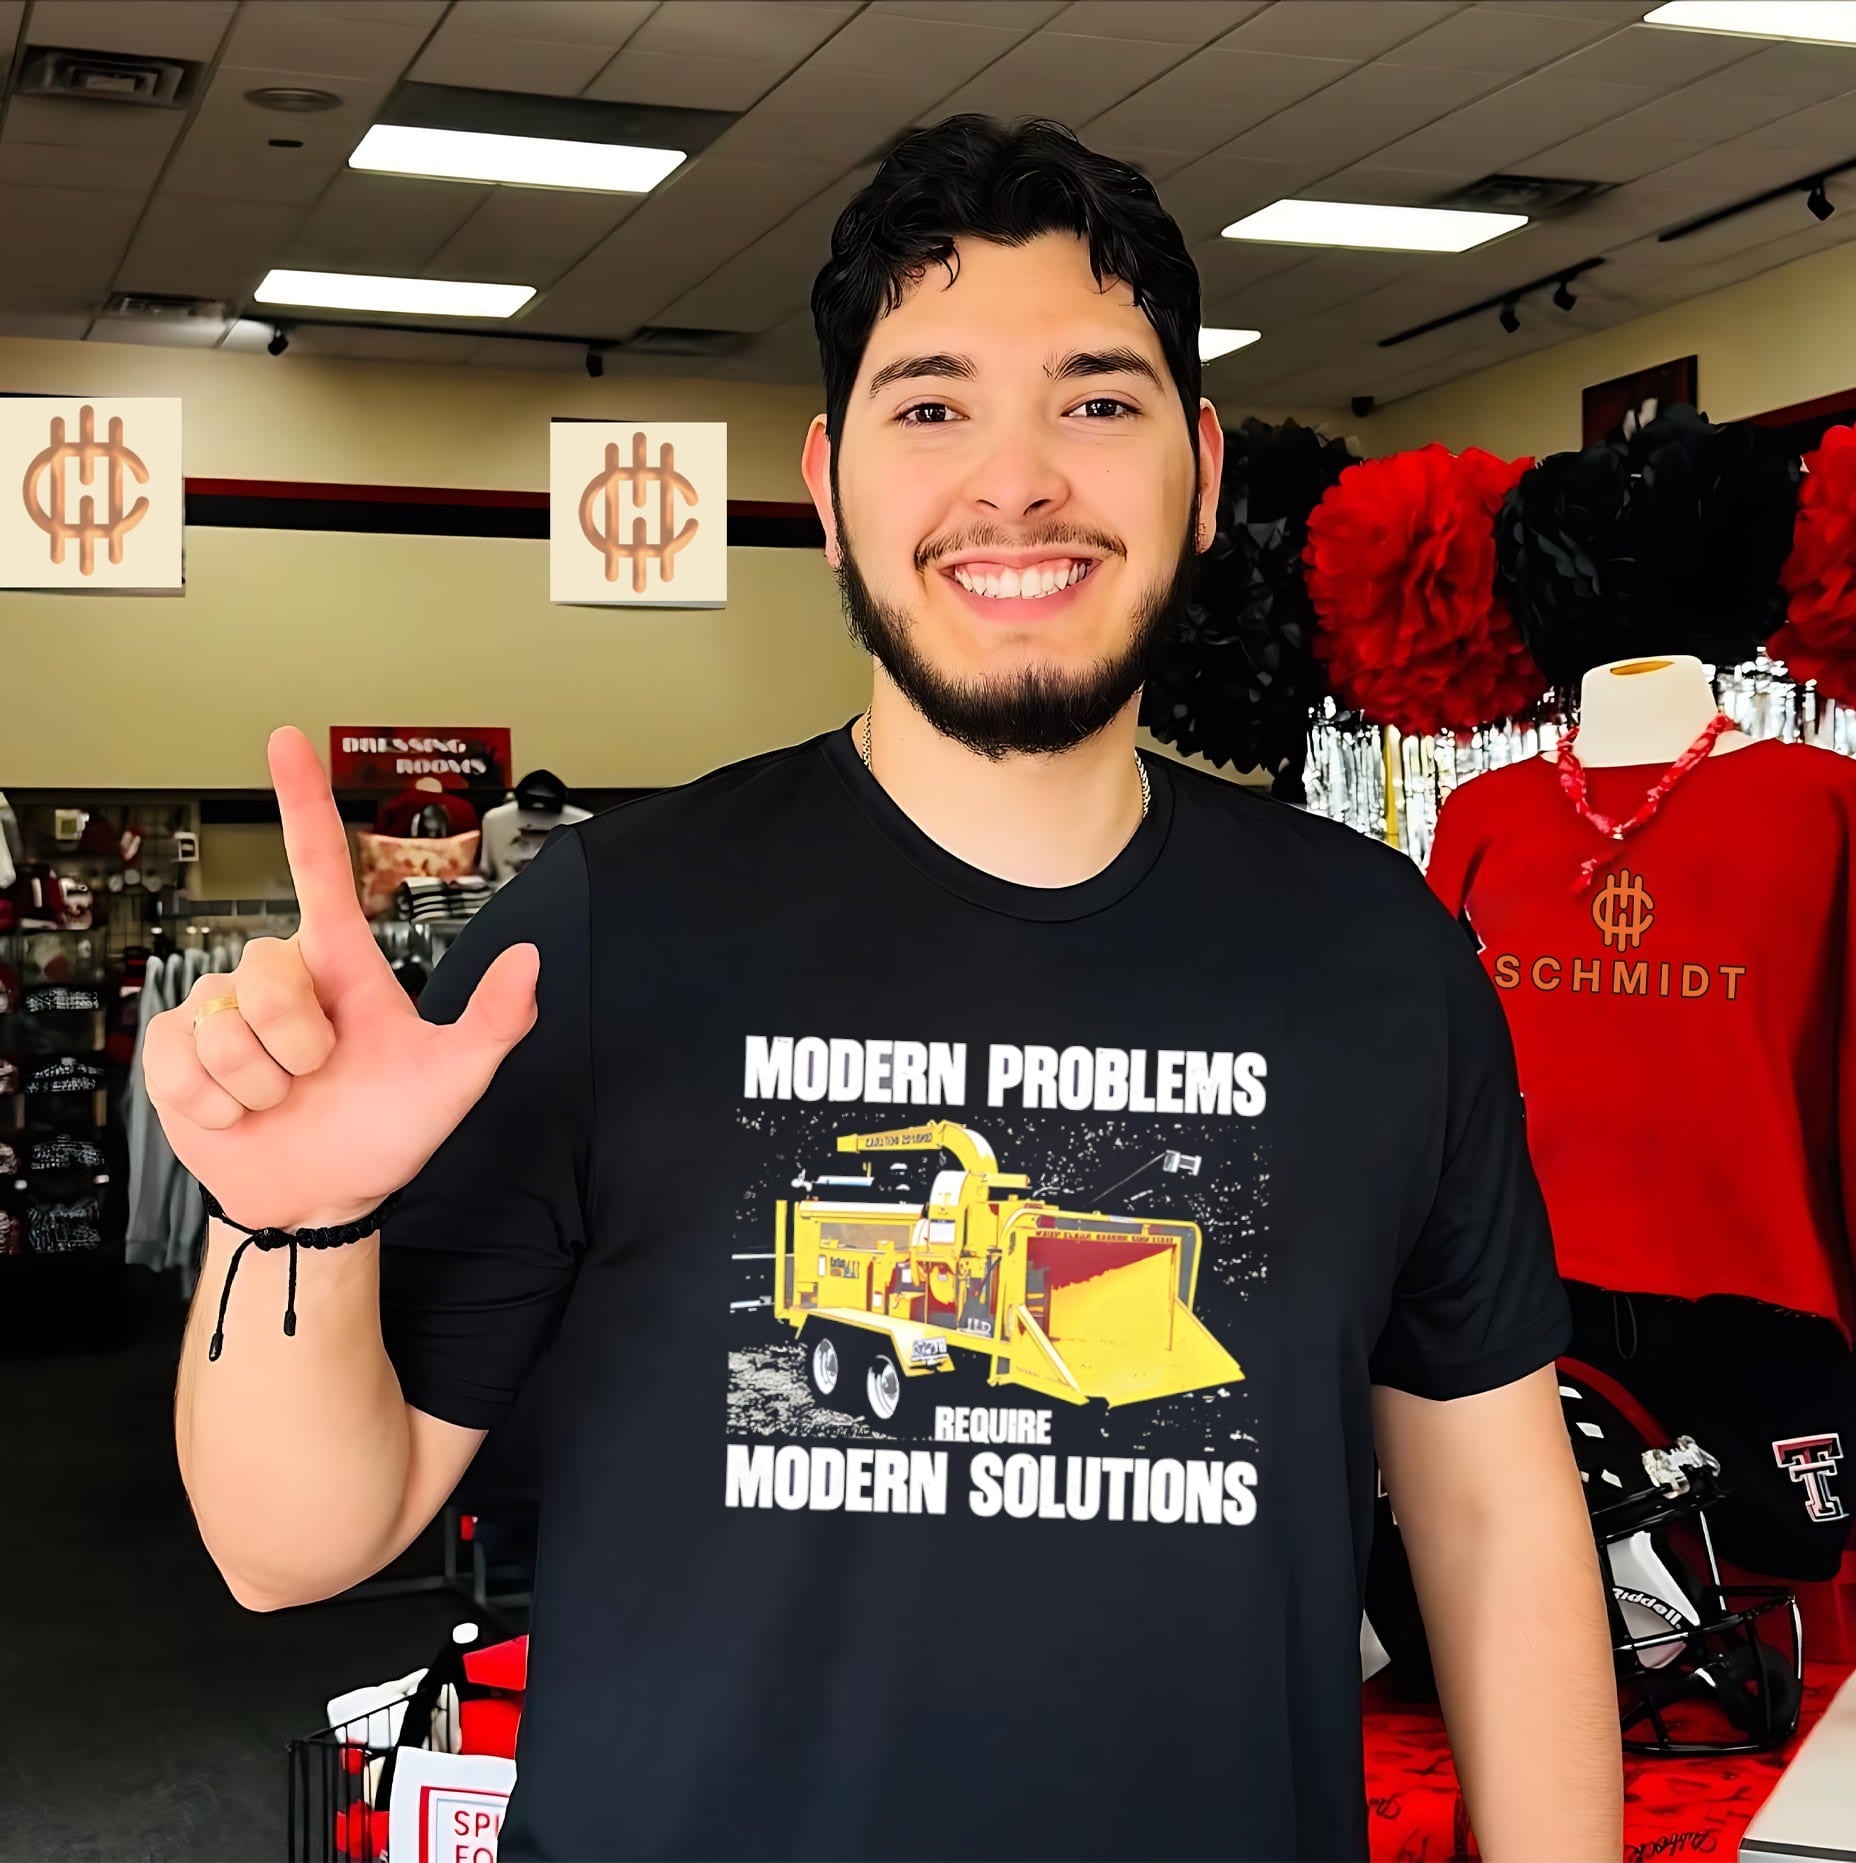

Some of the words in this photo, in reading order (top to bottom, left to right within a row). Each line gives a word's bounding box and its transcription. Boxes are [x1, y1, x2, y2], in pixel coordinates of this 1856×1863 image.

[342, 737, 467, 754] DRESSING
[396, 758, 487, 775] ROOMS
[1494, 953, 1747, 1000] SCHMIDT
[744, 1035, 967, 1106] MODERN
[987, 1044, 1268, 1117] PROBLEMS
[934, 1405, 1053, 1445] REQUIRE
[725, 1444, 949, 1515] MODERN
[968, 1451, 1258, 1527] SOLUTIONS
